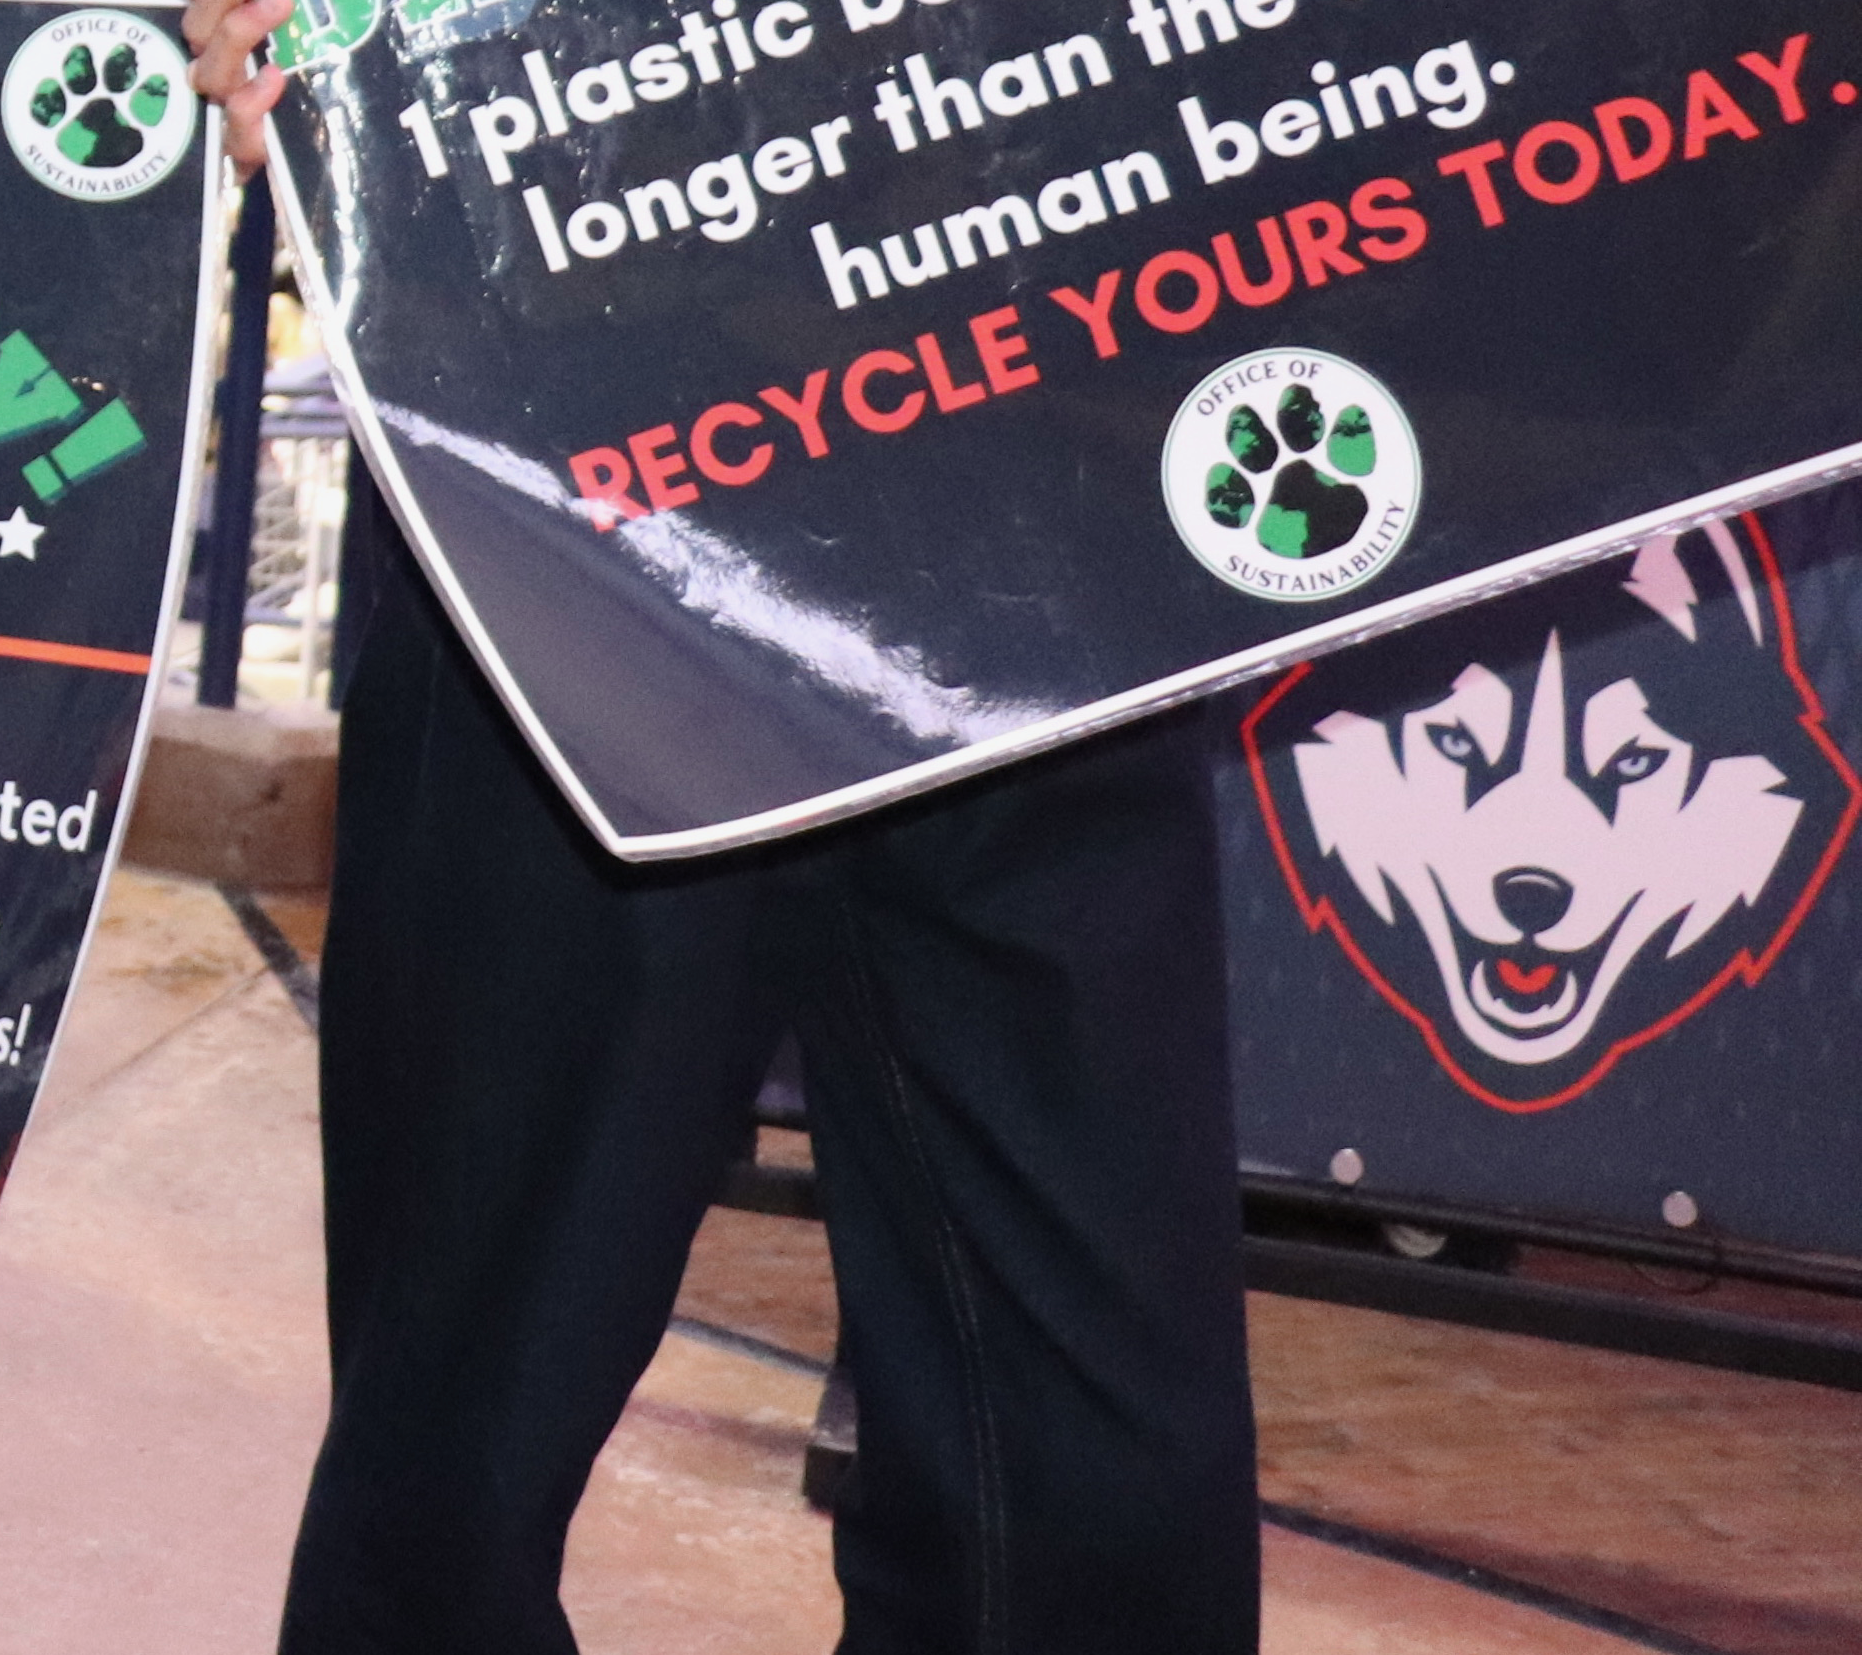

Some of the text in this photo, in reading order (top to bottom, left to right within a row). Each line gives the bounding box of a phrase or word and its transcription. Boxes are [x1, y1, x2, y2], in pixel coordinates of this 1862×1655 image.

[52, 18, 153, 45] OFFICE OF
[25, 144, 167, 194] SUSTAINABILITY
[399, 102, 449, 179] 1
[523, 115, 854, 274] longer
[875, 30, 1113, 154] than
[811, 37, 1515, 311] human being.
[569, 32, 1859, 533] RECYCLE YOURS TODAY.
[1197, 359, 1322, 417] OFFICE OF
[1224, 499, 1405, 593] SUSTAINABILITY
